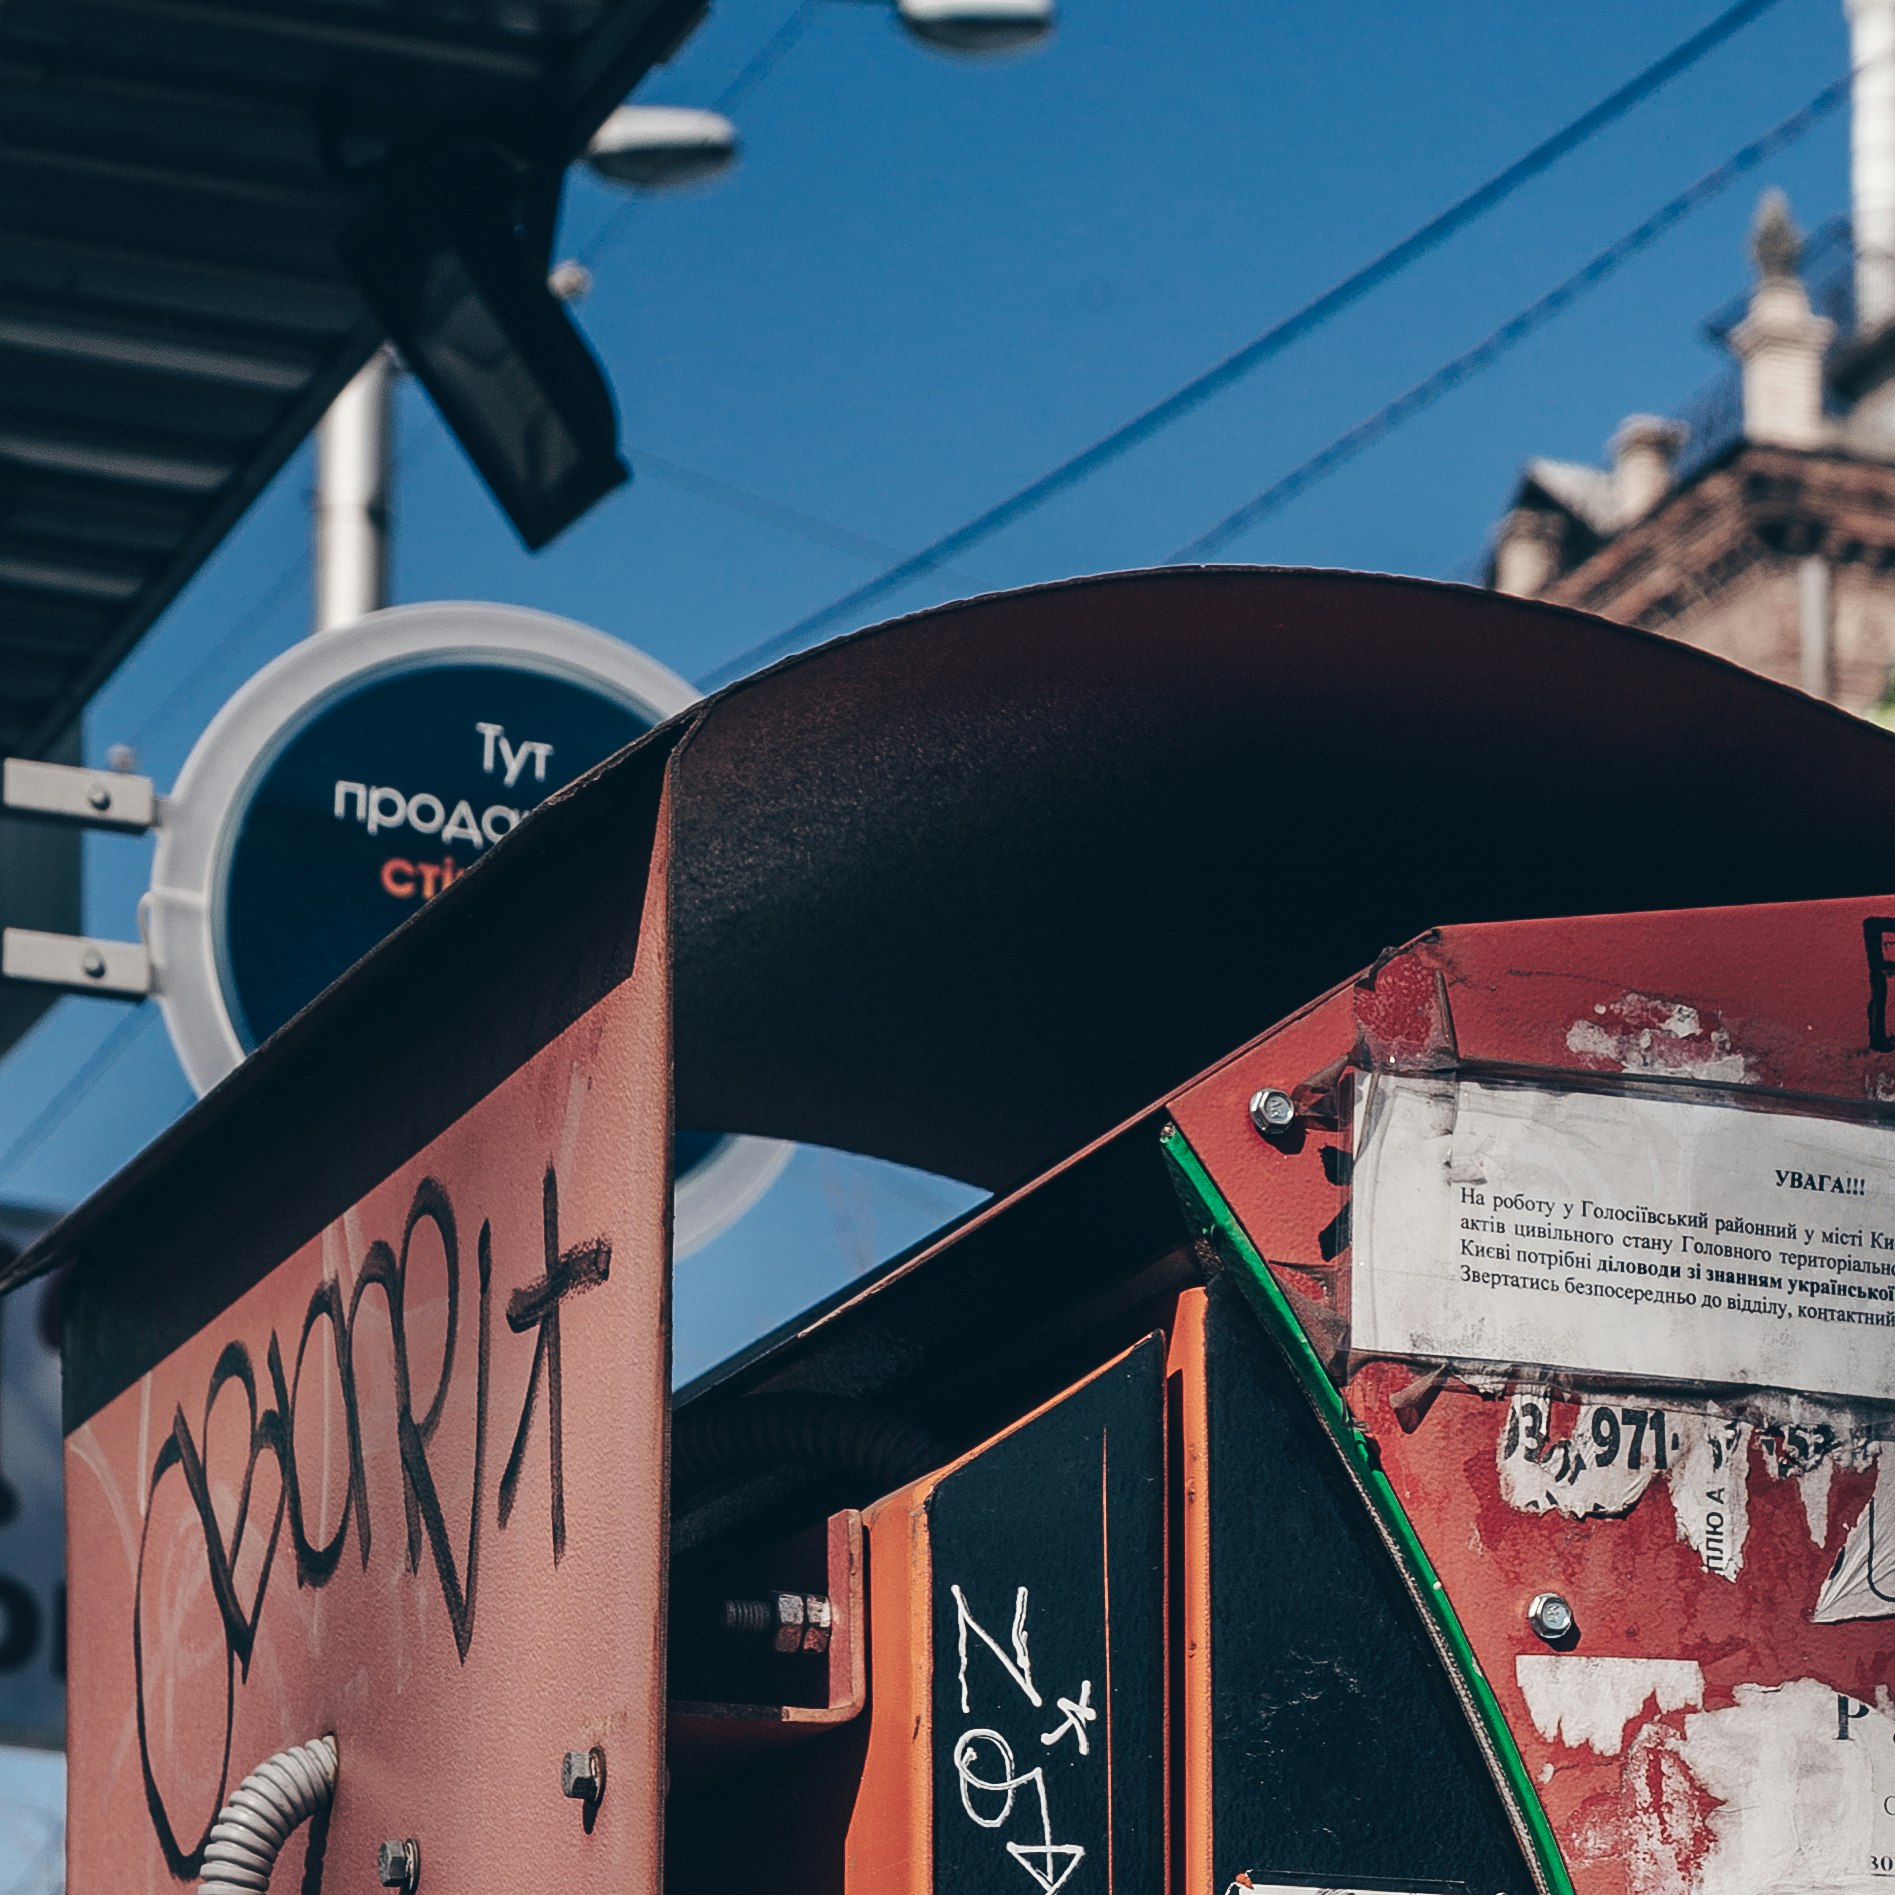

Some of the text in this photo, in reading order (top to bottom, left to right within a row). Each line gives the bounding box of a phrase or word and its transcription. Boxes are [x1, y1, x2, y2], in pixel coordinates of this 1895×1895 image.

[475, 721, 554, 788] Тут
[334, 779, 531, 849] прода
[380, 855, 467, 901] сті
[1774, 1169, 1866, 1196] УВАГА!!!
[1460, 1186, 1485, 1206] На
[1493, 1193, 1555, 1217] роботу
[1562, 1201, 1574, 1219] у
[1581, 1200, 1708, 1229] Голосіївський
[1715, 1216, 1797, 1240] районний
[1804, 1228, 1815, 1245] у
[1821, 1227, 1863, 1248] місті
[1460, 1215, 1506, 1235] актів
[1514, 1220, 1614, 1247] цивільного
[1622, 1233, 1673, 1255] стану
[1681, 1235, 1772, 1264] Головного
[1459, 1264, 1560, 1293] Звертатись
[1564, 1276, 1697, 1306] безпосередньо
[1701, 1295, 1722, 1310] до
[1727, 1296, 1793, 1320] відділу,
[1797, 1302, 1895, 1328] контактний
[1460, 1238, 1510, 1261] Києві
[1516, 1247, 1592, 1271] потрібні
[1596, 1257, 1682, 1279] діловоди
[1686, 1263, 1702, 1281] зі
[1705, 1269, 1783, 1290] знанням
[1787, 1278, 1895, 1302] української
